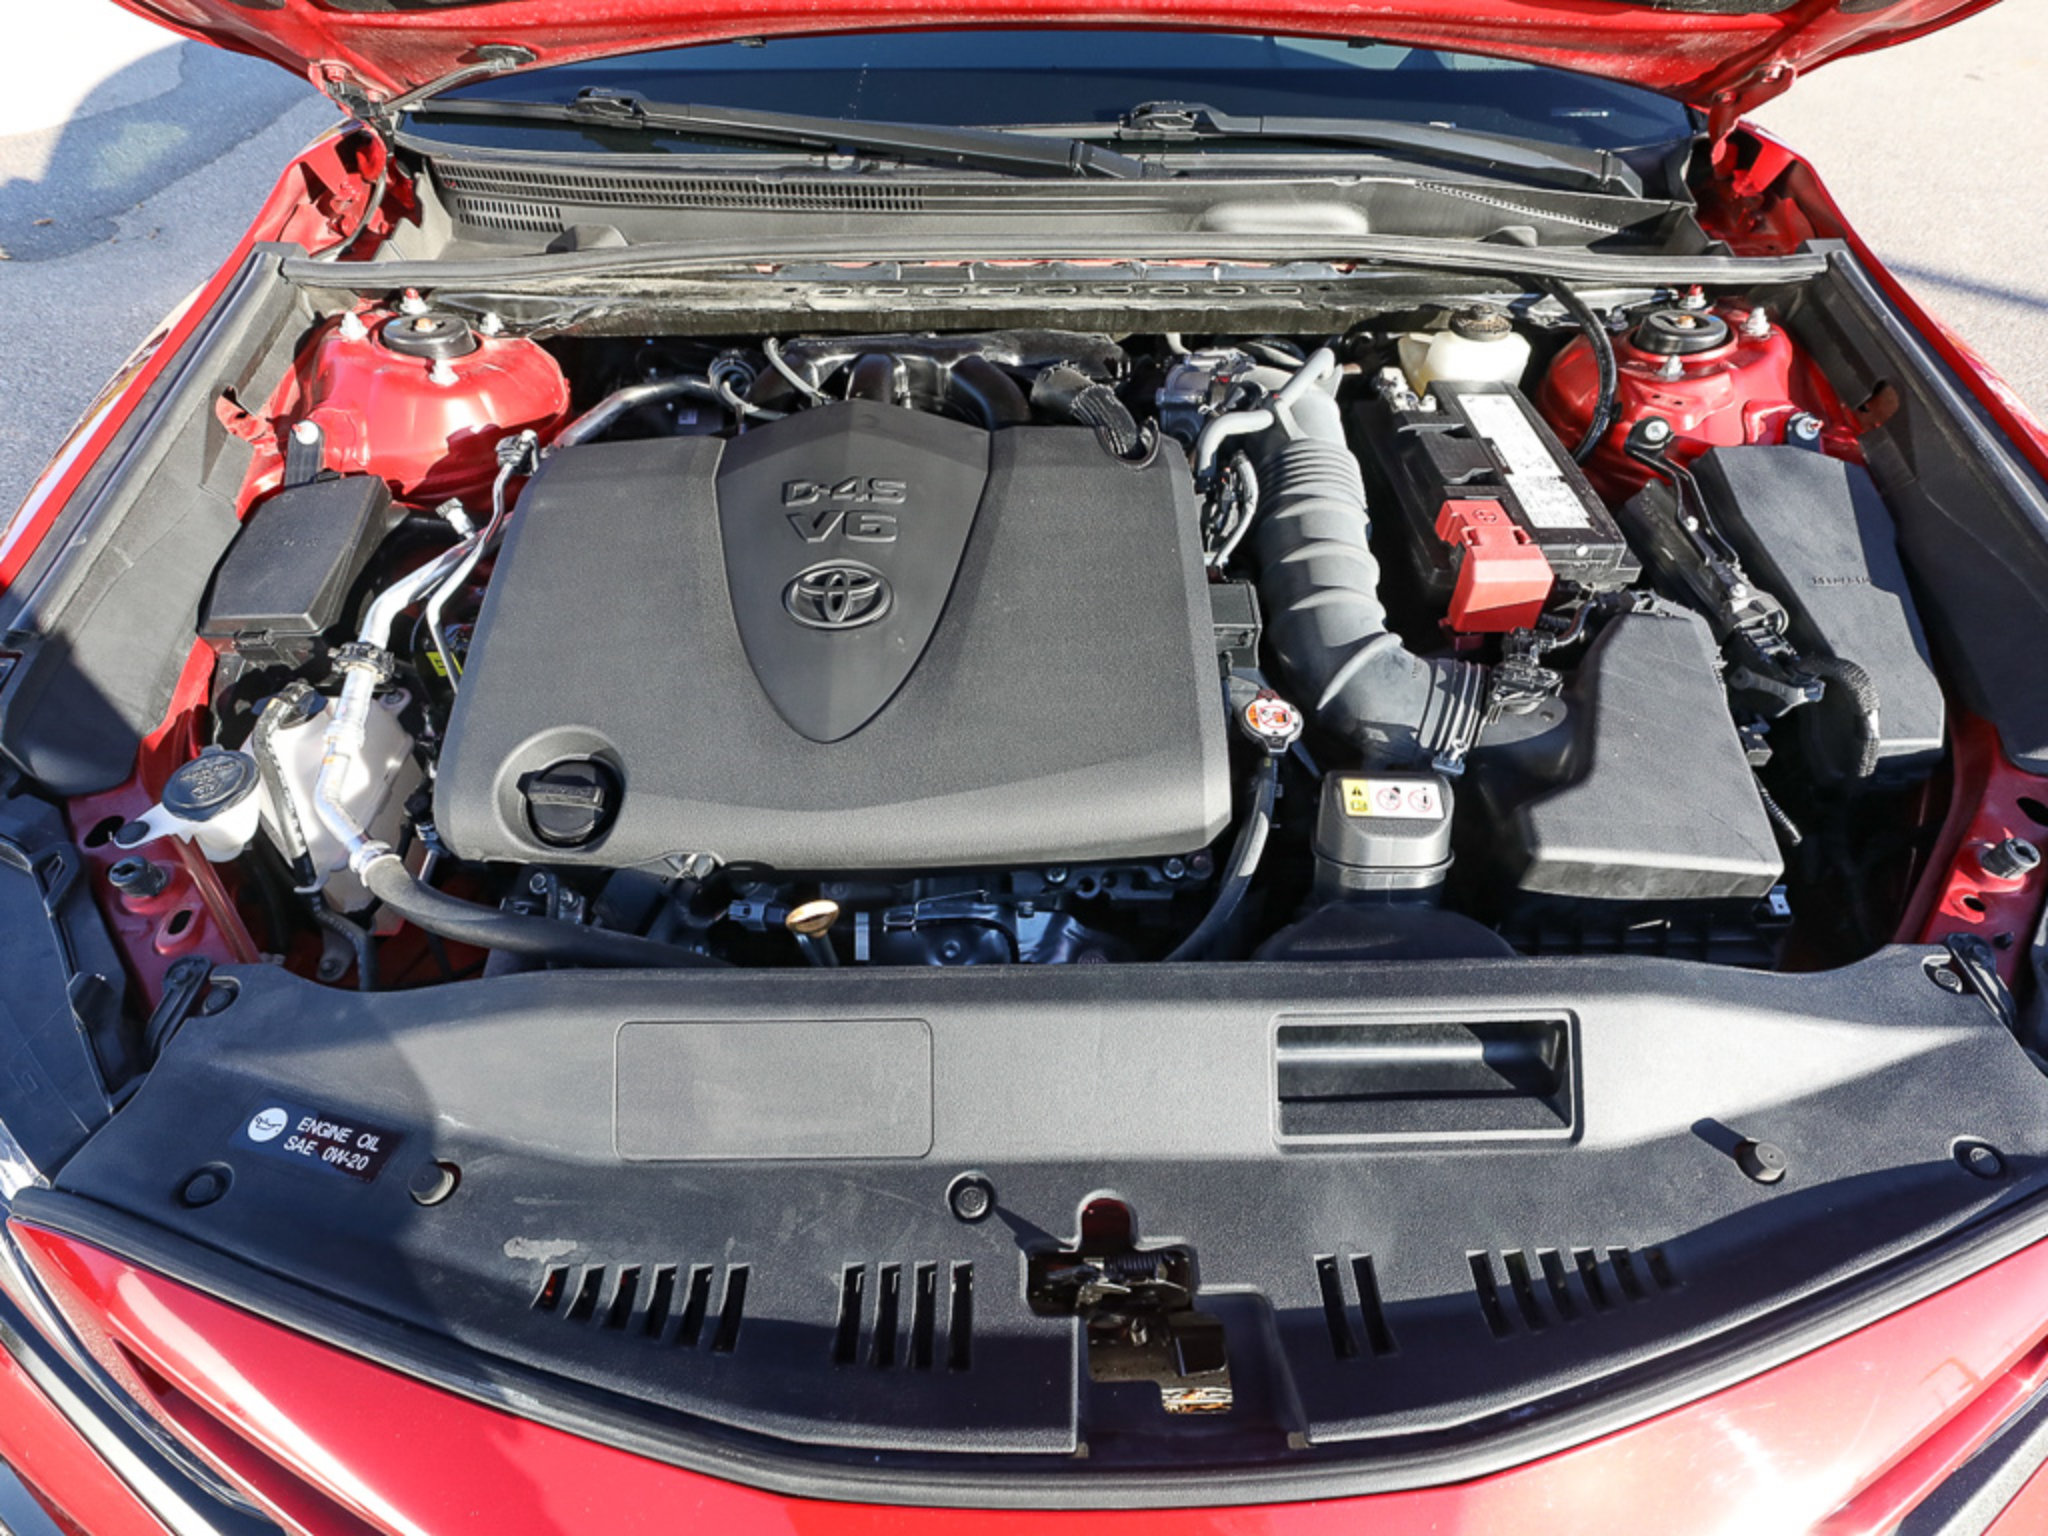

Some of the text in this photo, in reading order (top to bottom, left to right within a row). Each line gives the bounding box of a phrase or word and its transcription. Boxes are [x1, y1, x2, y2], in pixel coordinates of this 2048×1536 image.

[785, 509, 897, 544] V6
[297, 1116, 380, 1152] ENGINE OIL
[283, 1135, 369, 1171] SAE 0W-20
